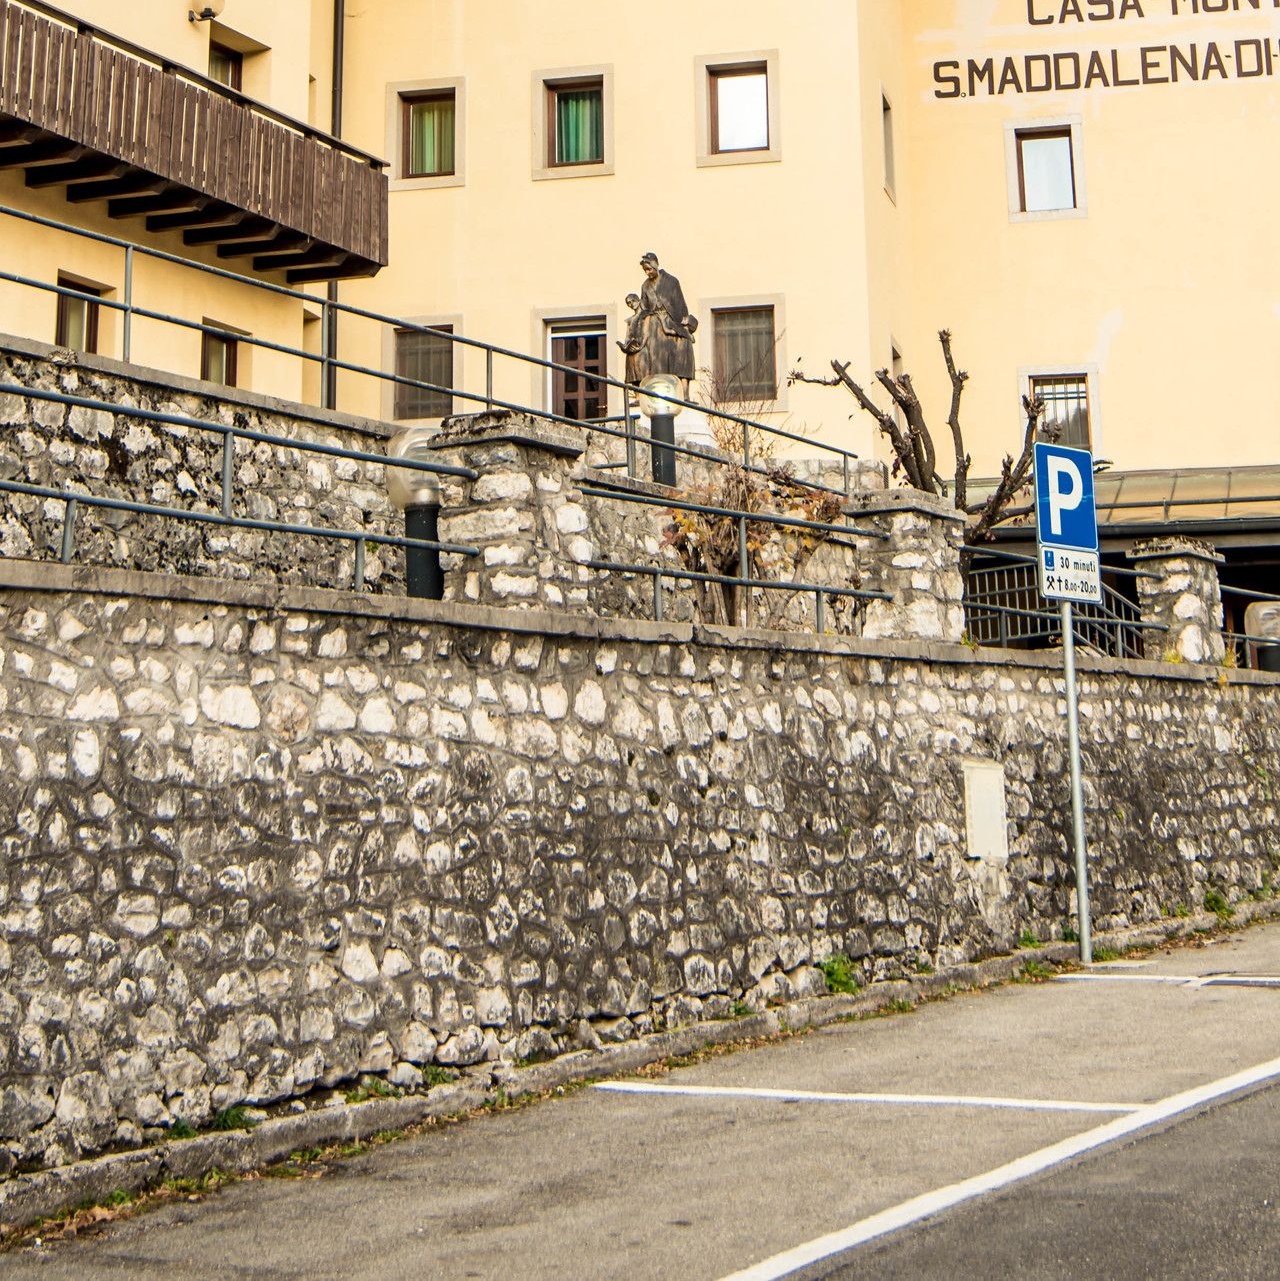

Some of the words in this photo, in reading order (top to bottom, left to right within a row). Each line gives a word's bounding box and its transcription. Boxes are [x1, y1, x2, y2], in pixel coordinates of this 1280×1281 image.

[1047, 455, 1083, 535] P
[1060, 556, 1070, 569] 30
[1073, 560, 1096, 572] minuti
